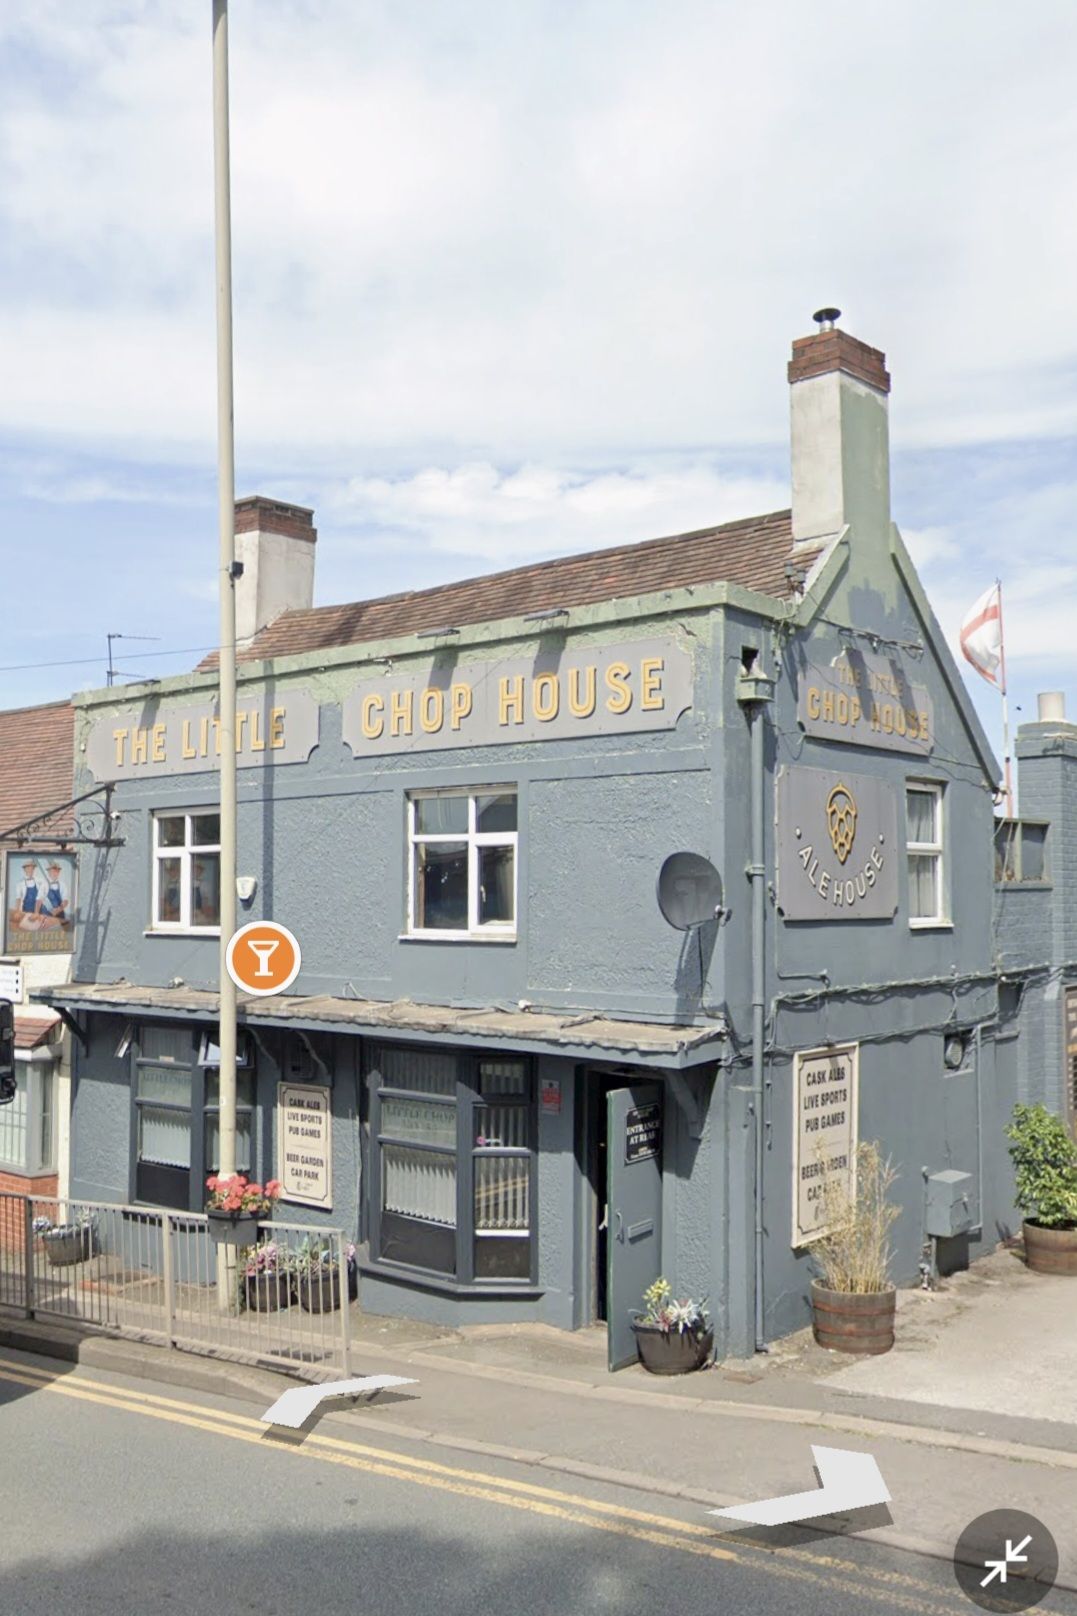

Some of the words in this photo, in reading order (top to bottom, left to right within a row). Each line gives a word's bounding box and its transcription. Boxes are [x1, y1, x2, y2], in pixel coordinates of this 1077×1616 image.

[836, 664, 862, 689] THE
[361, 682, 473, 739] CHOP
[499, 656, 665, 727] HOUSE
[807, 687, 861, 727] CHOP
[871, 702, 929, 741] HOUSE
[113, 723, 167, 766] THE
[806, 1070, 827, 1086] CASK
[828, 1066, 846, 1082] ALES
[289, 1097, 304, 1107] CASK
[306, 1100, 320, 1110] ALES
[803, 1094, 819, 1110] LIVE
[821, 1088, 847, 1107] SPORTS
[287, 1111, 299, 1122] LIVE
[300, 1113, 322, 1126] SPORTS
[805, 1117, 819, 1133] PUB
[821, 1111, 845, 1129] GAMES
[289, 1125, 299, 1136] PUB
[301, 1127, 321, 1139] GAMES
[630, 1135, 638, 1145] AT
[286, 1152, 300, 1163] BEER
[300, 1155, 324, 1168] GARDEN
[291, 1167, 303, 1178] CAR
[304, 1169, 319, 1180] PARK
[801, 1162, 819, 1180] BEER
